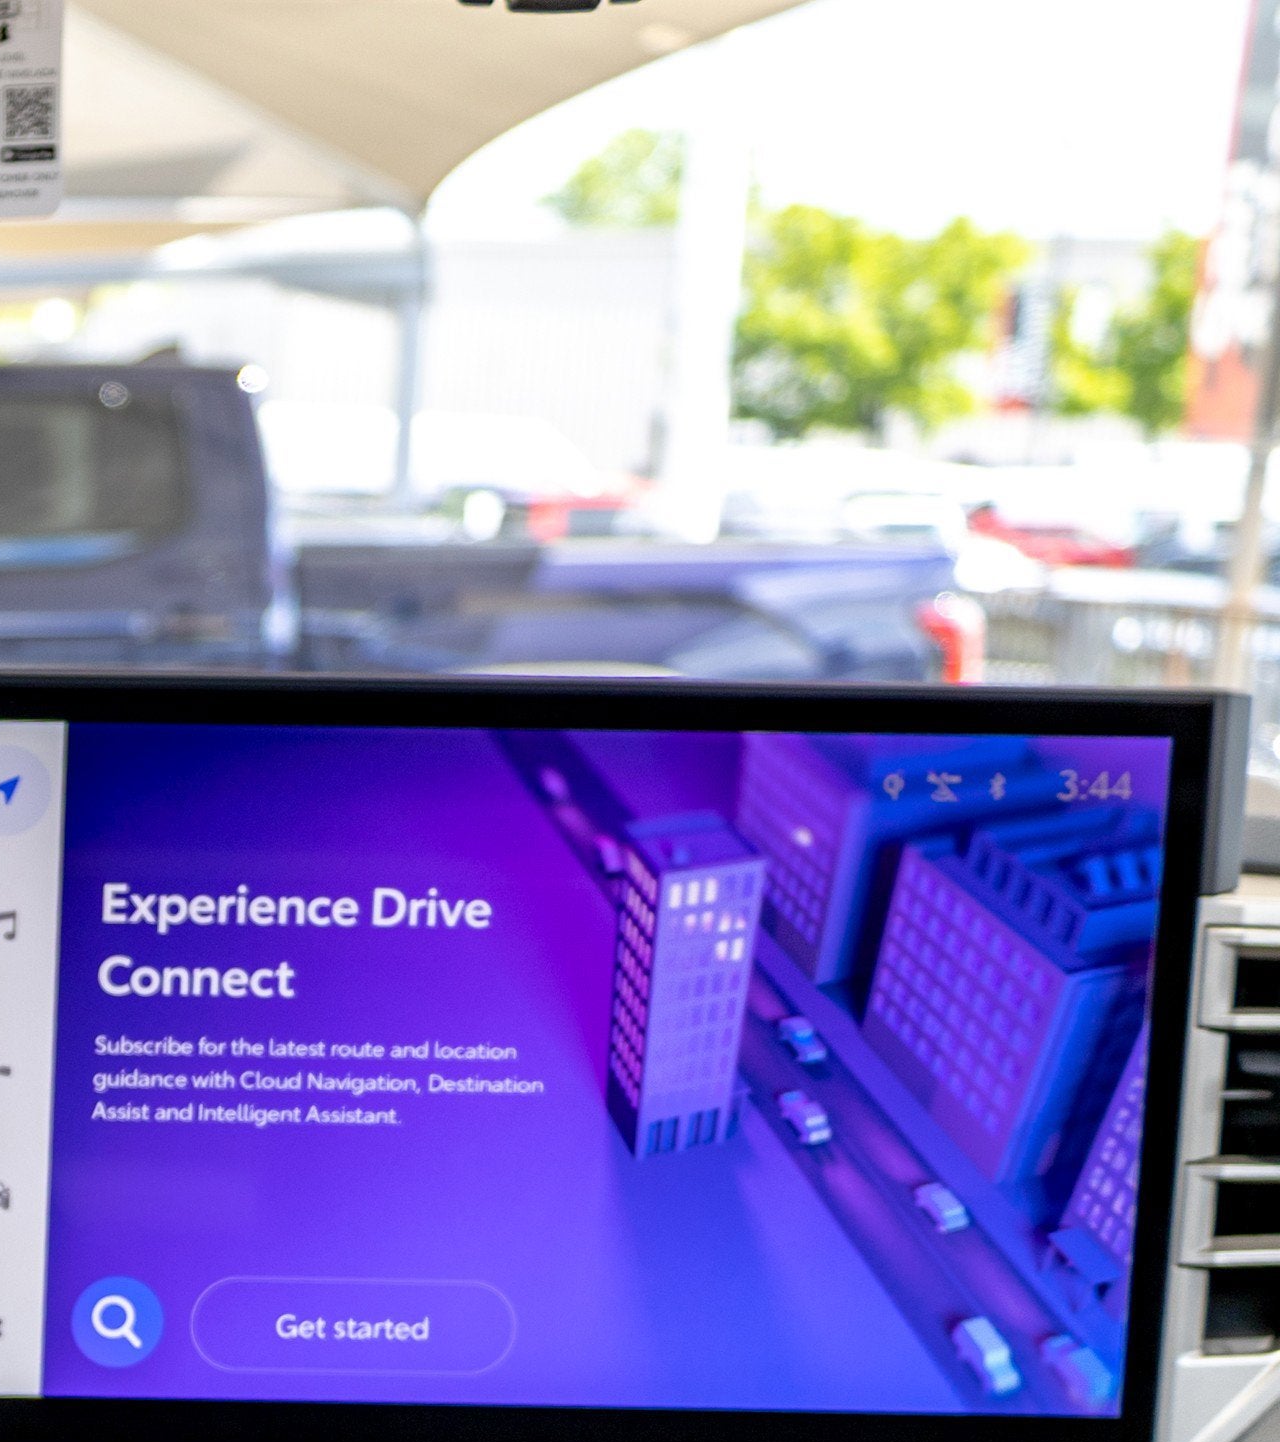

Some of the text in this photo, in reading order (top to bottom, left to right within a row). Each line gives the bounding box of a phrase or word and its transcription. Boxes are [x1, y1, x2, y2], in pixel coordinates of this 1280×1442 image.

[1057, 769, 1132, 800] 3:44
[101, 882, 492, 934] Experience Drive
[97, 954, 295, 997] Connect
[94, 1035, 517, 1061] Subscribe for the latest route and location
[92, 1069, 544, 1097] guidance with Cloud Navigation, Destination
[91, 1101, 402, 1127] Assist and Intelligent Assistant.
